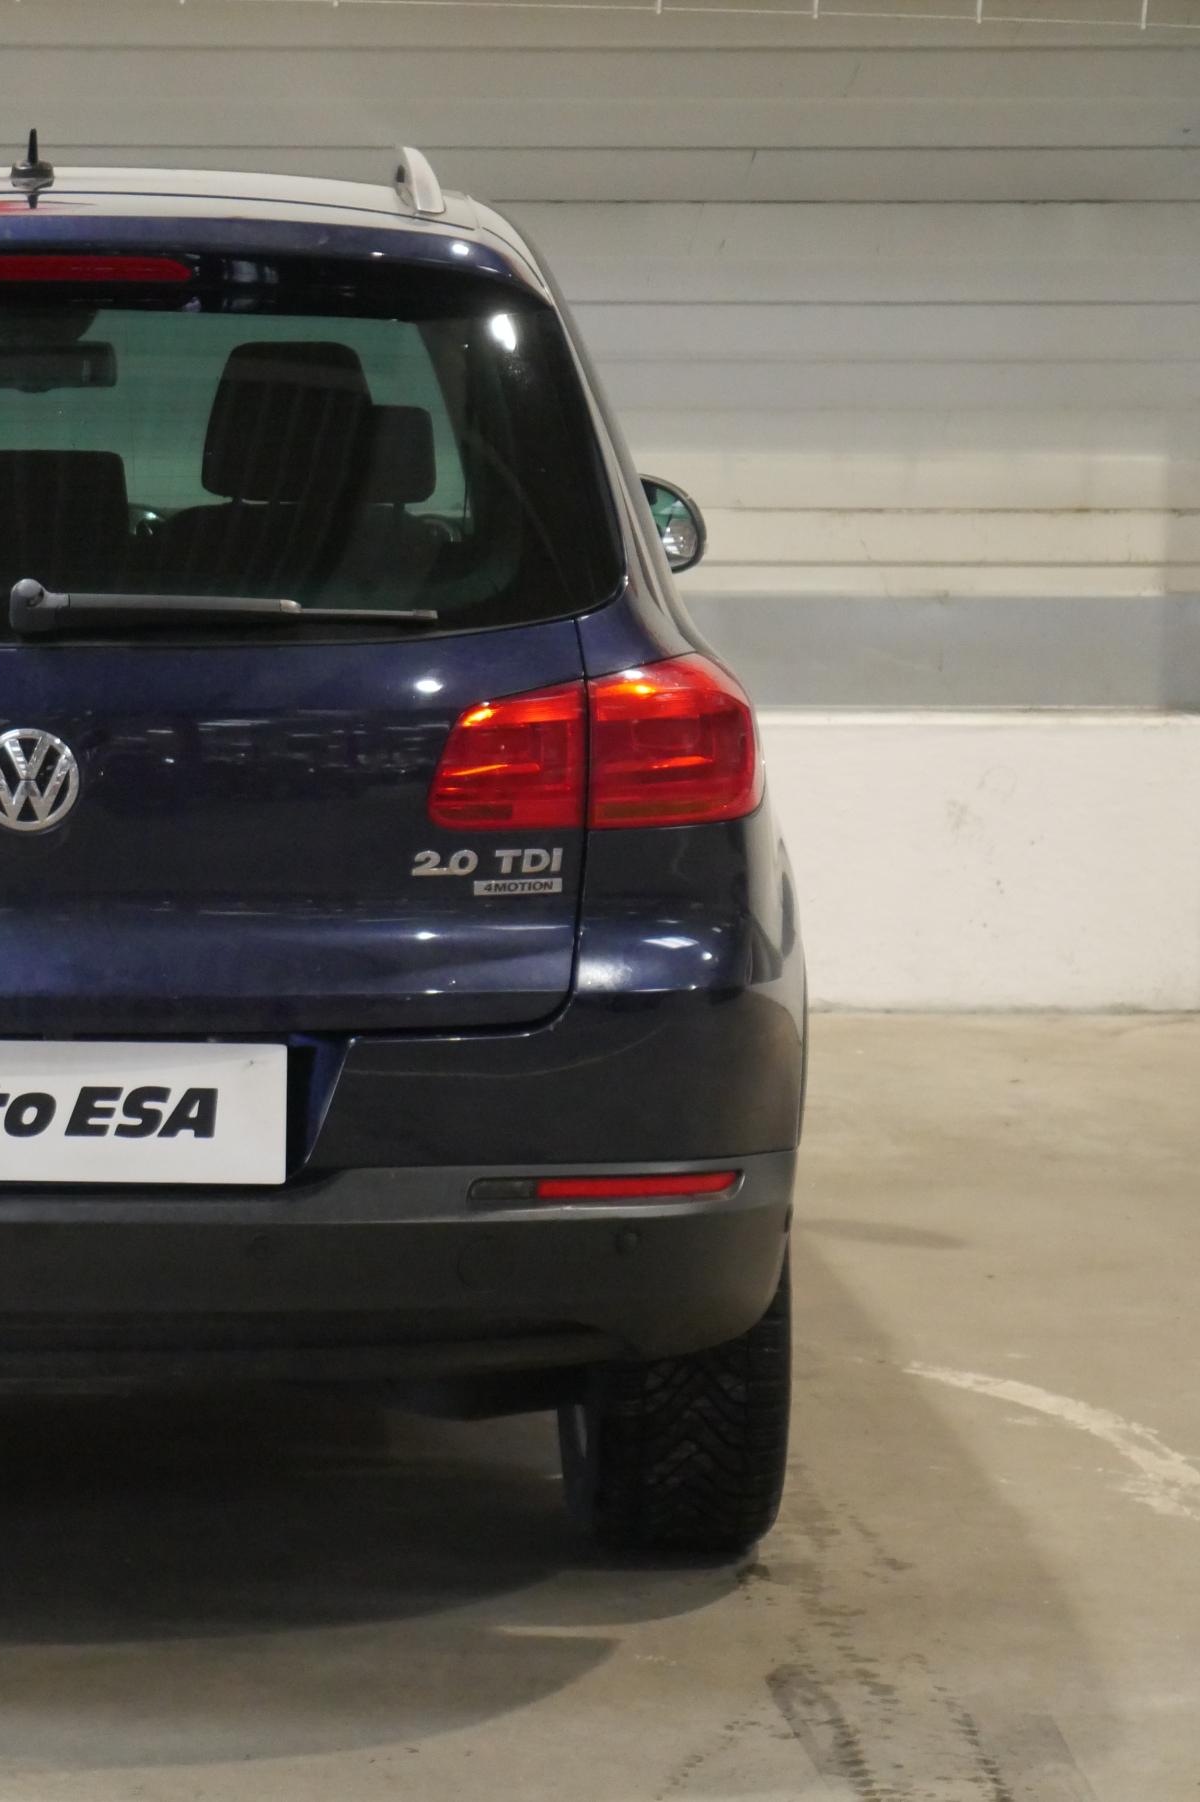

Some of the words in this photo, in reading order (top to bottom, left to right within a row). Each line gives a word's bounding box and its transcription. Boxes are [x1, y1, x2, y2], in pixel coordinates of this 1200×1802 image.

[411, 849, 478, 876] 2.0
[494, 848, 563, 874] TDI
[483, 881, 554, 893] 4MOTION
[64, 1086, 218, 1138] ESA
